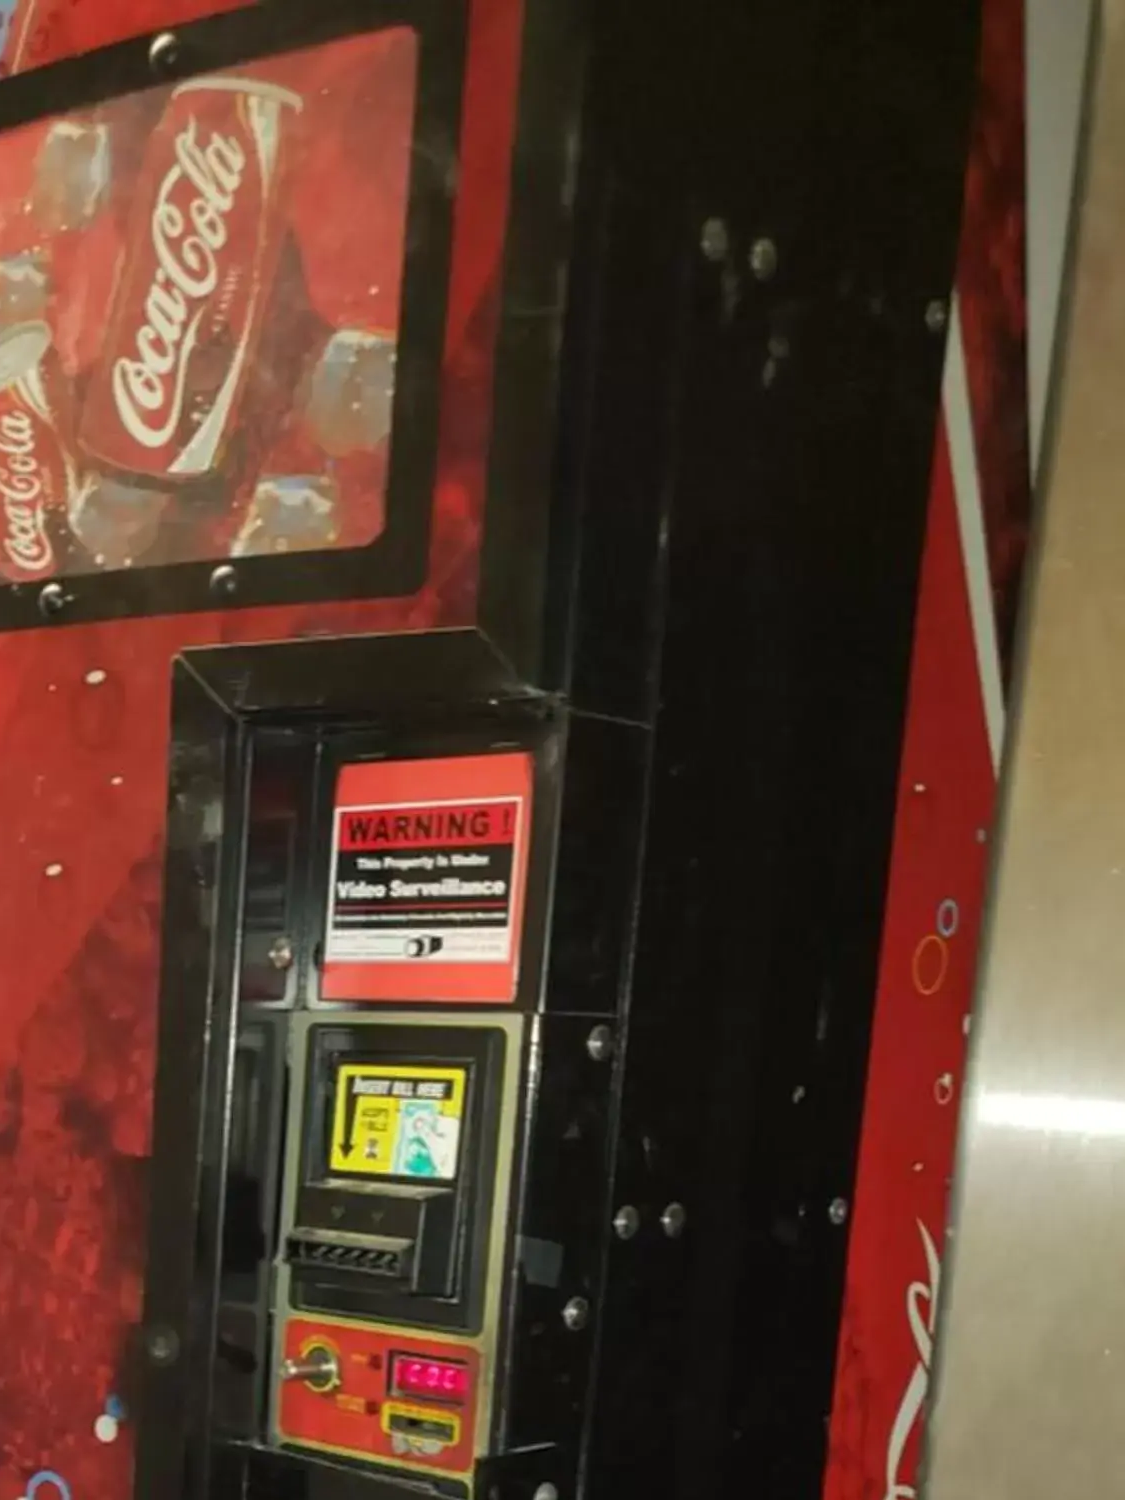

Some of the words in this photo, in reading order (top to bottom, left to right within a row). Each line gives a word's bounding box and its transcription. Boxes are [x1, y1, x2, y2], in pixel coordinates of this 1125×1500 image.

[348, 811, 490, 843] WARNING
[337, 880, 386, 898] Video
[389, 877, 506, 897] Surveillance
